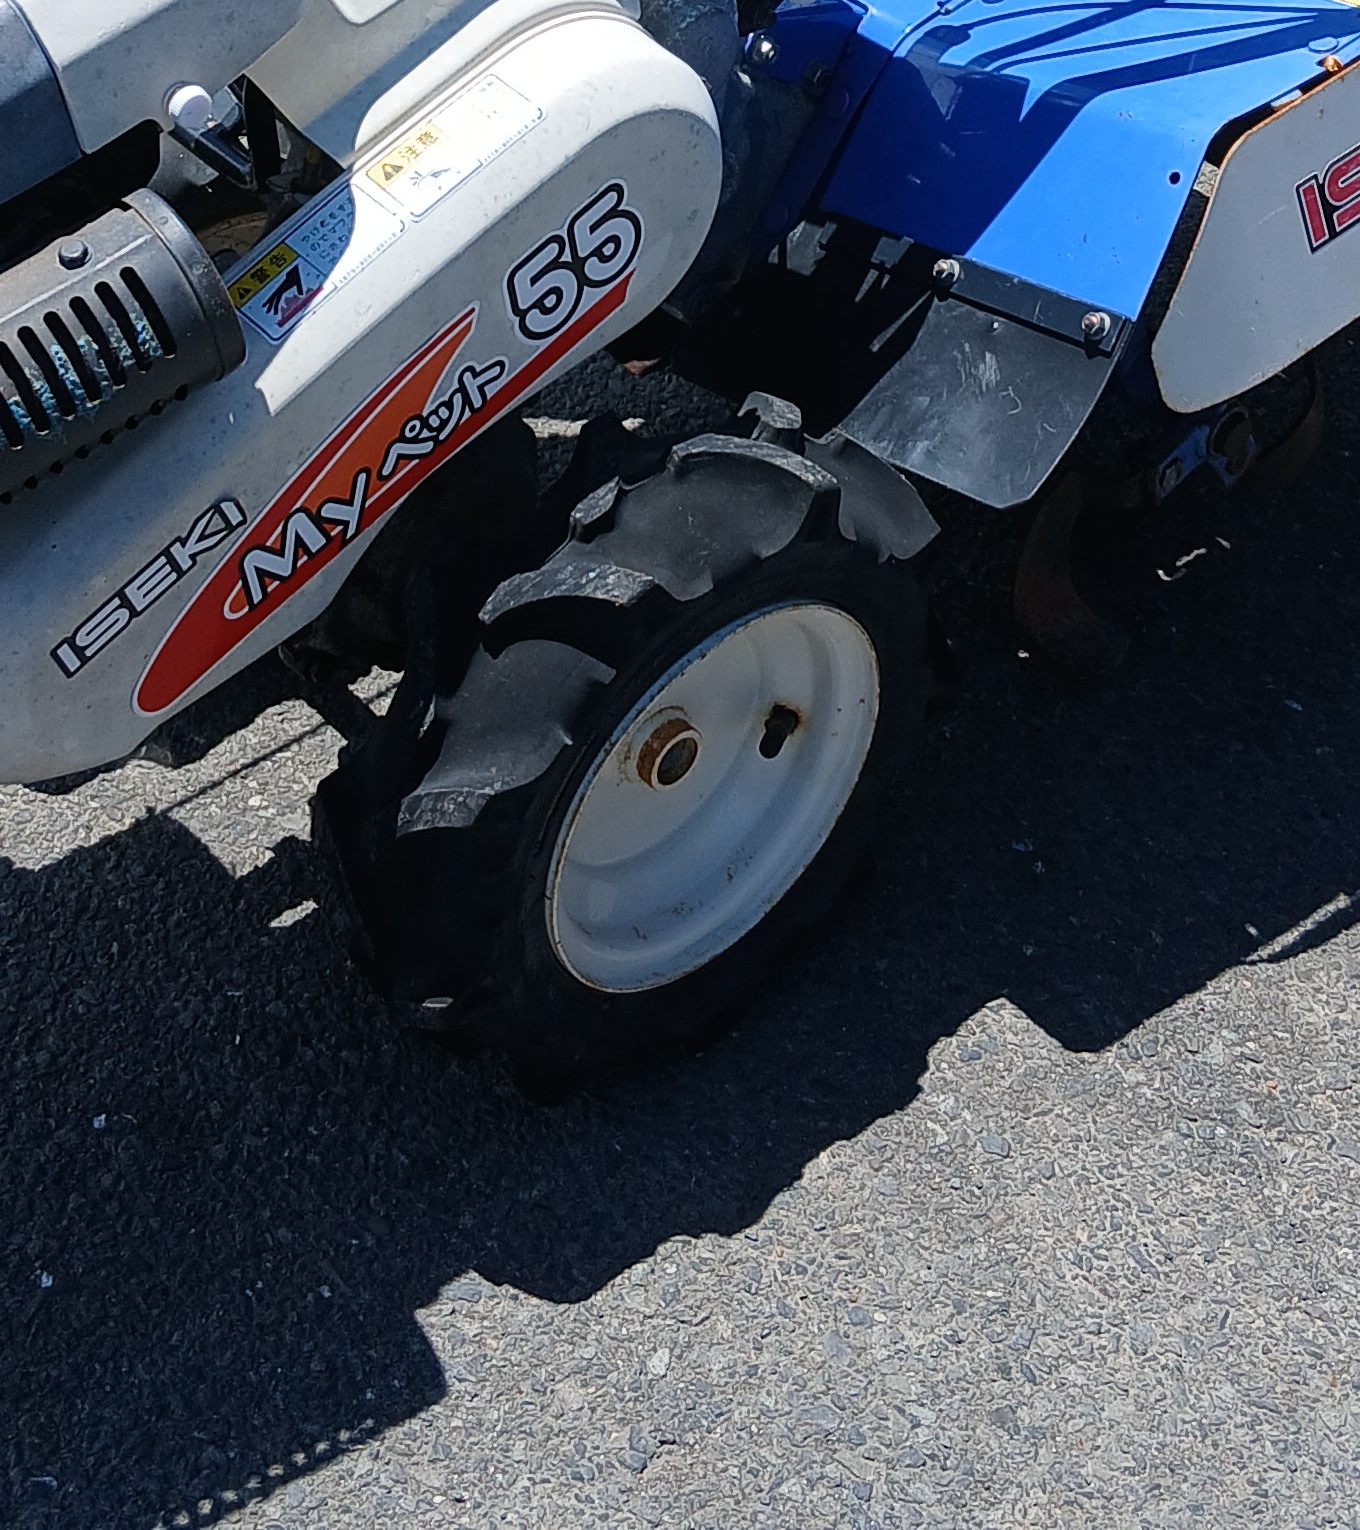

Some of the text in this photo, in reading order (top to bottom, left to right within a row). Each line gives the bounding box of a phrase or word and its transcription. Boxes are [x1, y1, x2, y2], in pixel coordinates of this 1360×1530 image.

[402, 130, 440, 164] 注意
[249, 252, 288, 286] 警告
[506, 178, 642, 342] 55
[241, 359, 507, 611] My ペット
[50, 498, 248, 679] ISEKI
